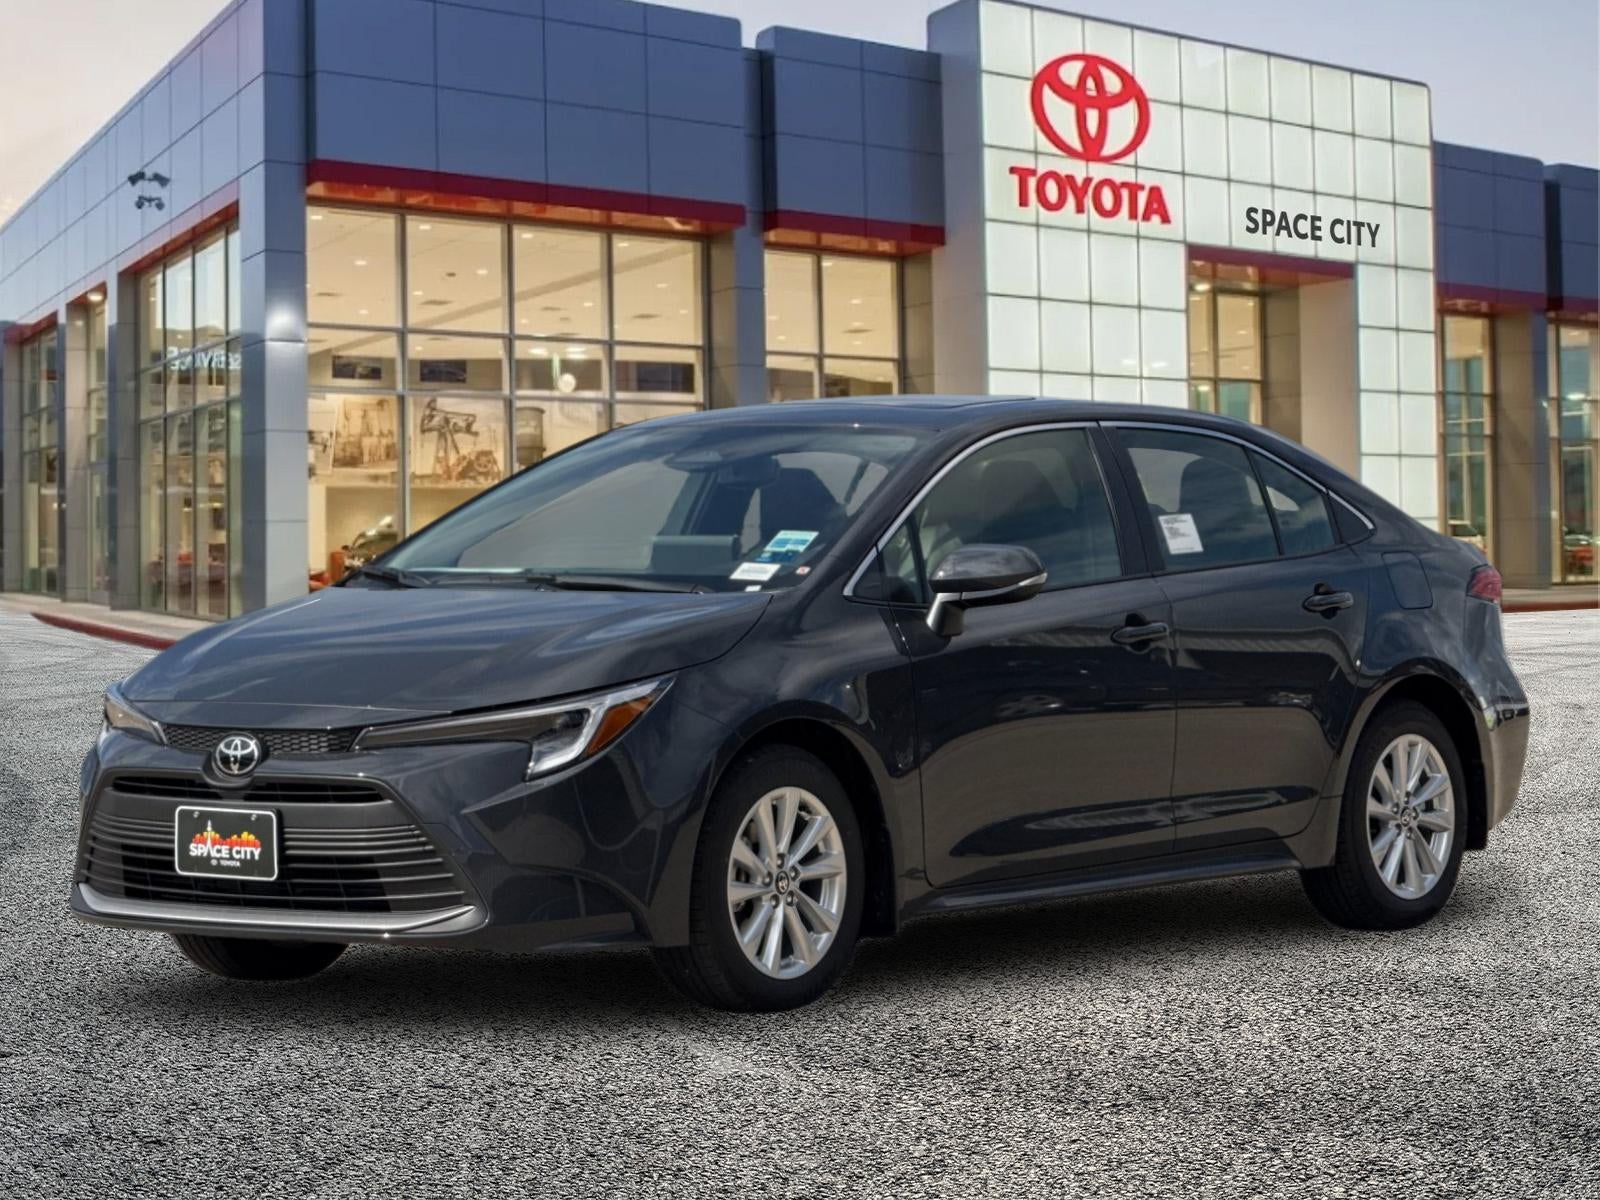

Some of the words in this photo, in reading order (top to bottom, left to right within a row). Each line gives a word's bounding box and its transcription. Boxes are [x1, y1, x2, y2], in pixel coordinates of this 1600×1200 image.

[1008, 165, 1172, 225] TOYOTA
[1245, 206, 1322, 242] SPACE
[1329, 217, 1381, 248] CITY
[189, 842, 230, 858] SPACE
[232, 846, 261, 861] CITY
